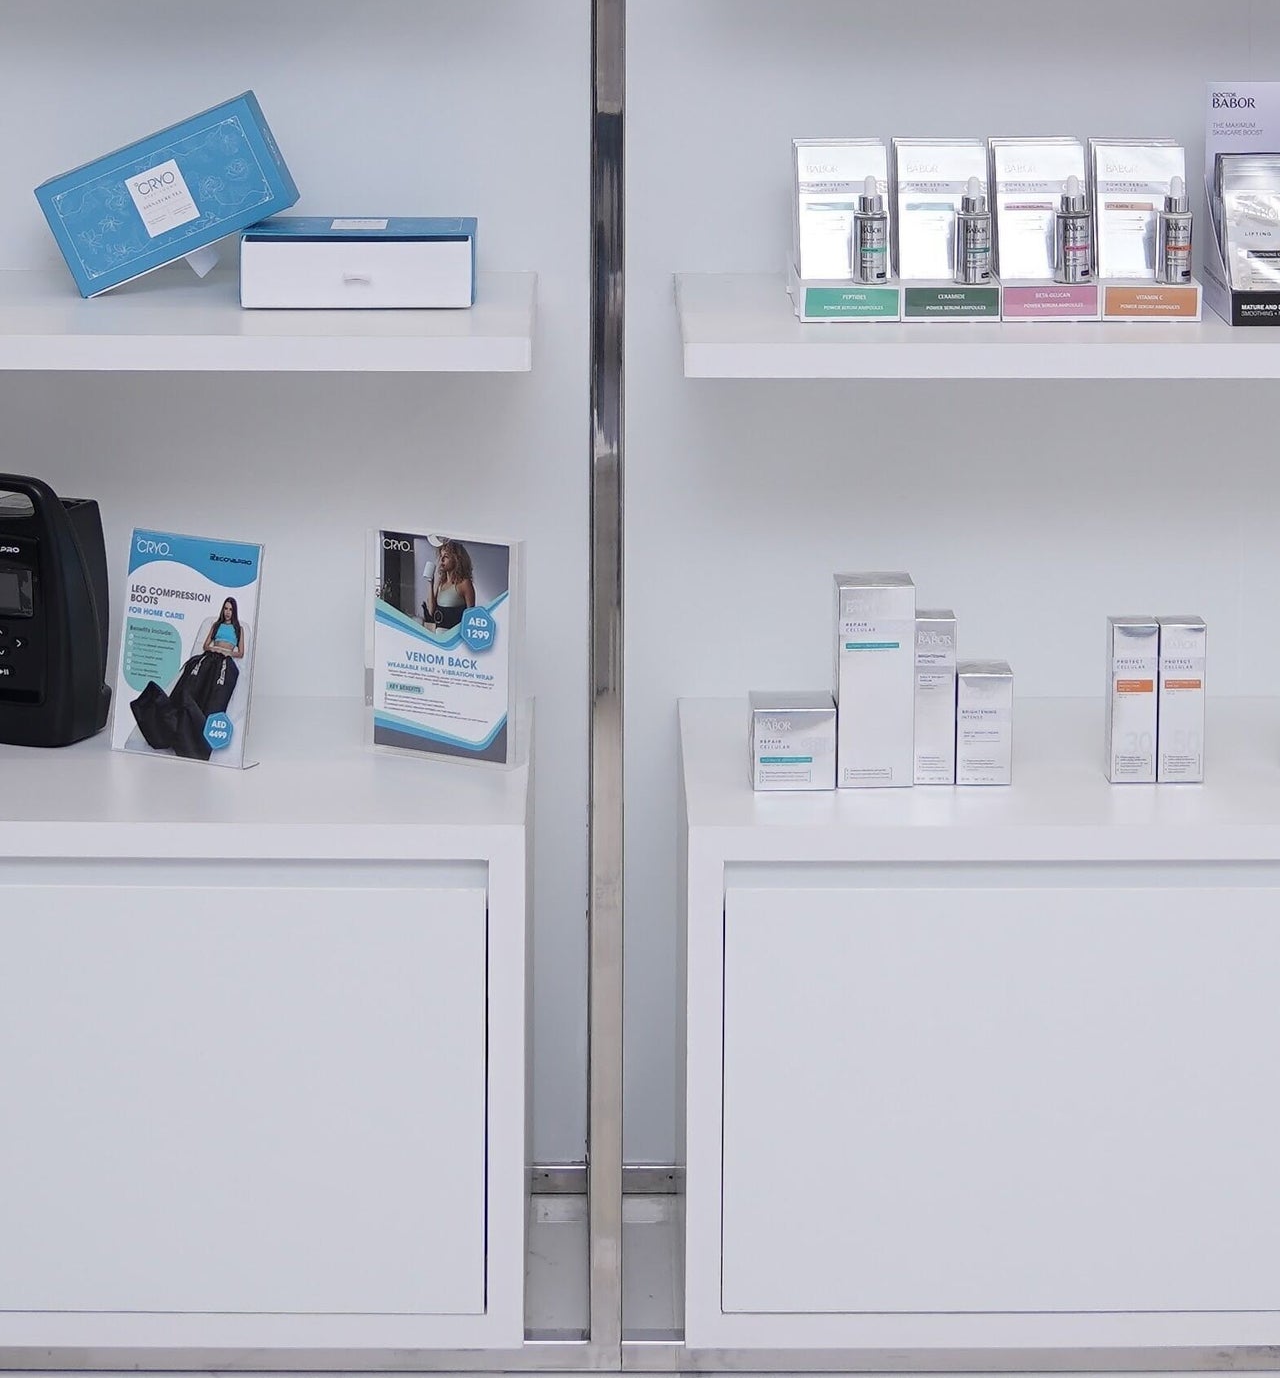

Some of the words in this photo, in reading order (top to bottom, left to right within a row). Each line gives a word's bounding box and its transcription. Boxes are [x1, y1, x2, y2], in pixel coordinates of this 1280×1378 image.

[1212, 98, 1255, 109] BABOR
[131, 594, 158, 605] BOOTS
[132, 585, 147, 594] LEG
[149, 587, 211, 603] COMPRESSION
[468, 617, 487, 627] AED
[467, 628, 489, 639] 1299
[406, 651, 445, 665] VENOM
[448, 657, 478, 670] BACK
[209, 729, 227, 740] 4499
